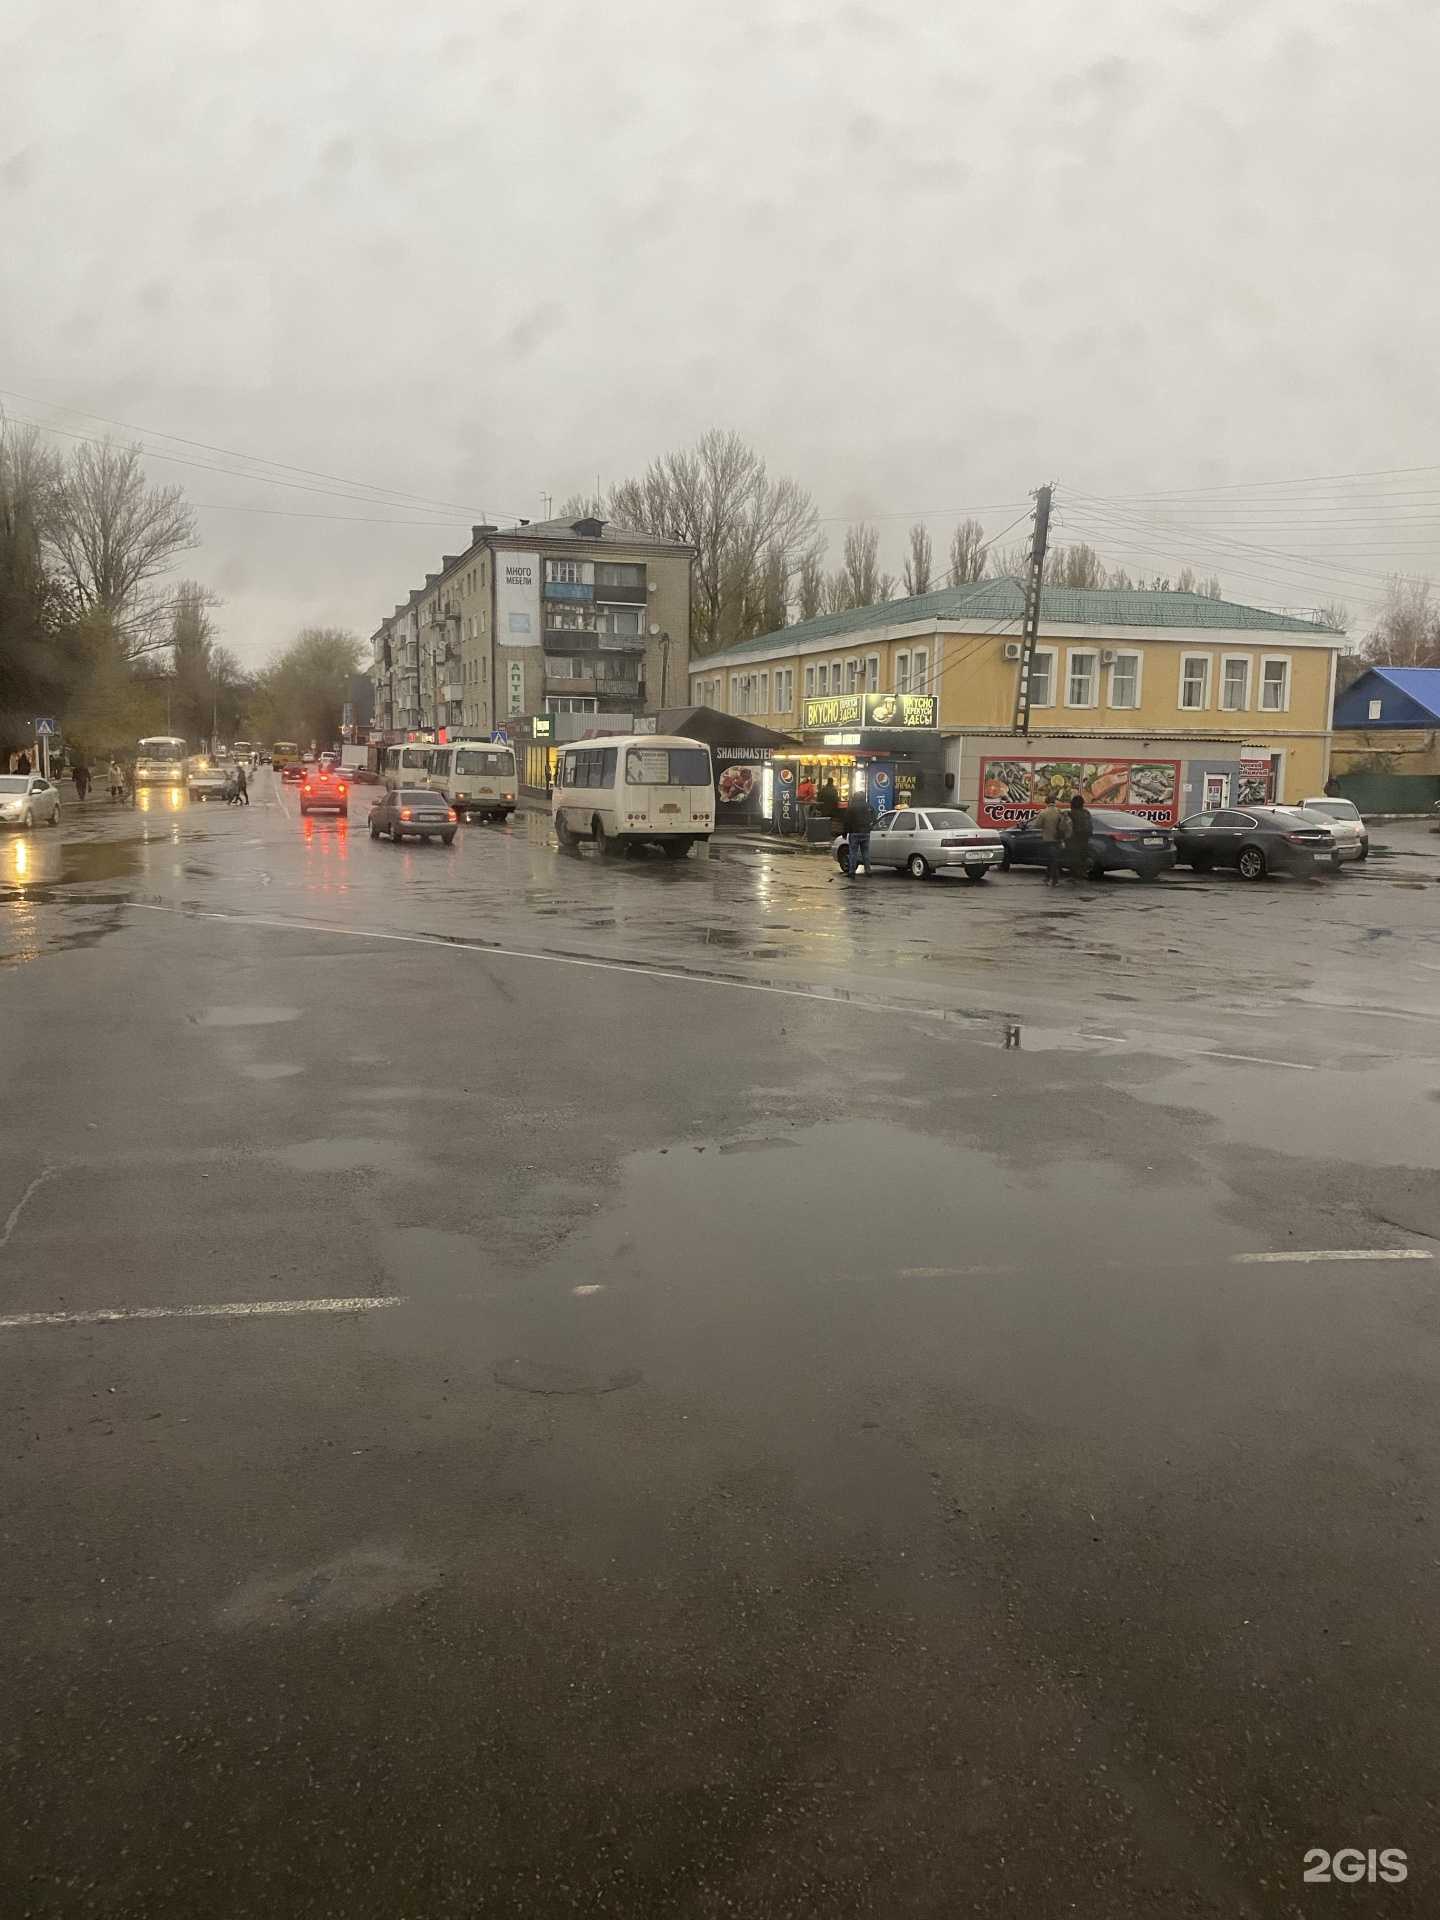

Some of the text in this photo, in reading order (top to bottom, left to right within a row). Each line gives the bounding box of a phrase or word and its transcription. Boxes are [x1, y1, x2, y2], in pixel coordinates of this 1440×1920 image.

[506, 566, 532, 577] МНОГО
[506, 577, 532, 585] МЕБЕЛИ
[511, 663, 521, 714] АПТЕК
[904, 697, 933, 708] ВКУСНО
[808, 702, 839, 726] ВКУСНО
[782, 790, 792, 820] pepsi
